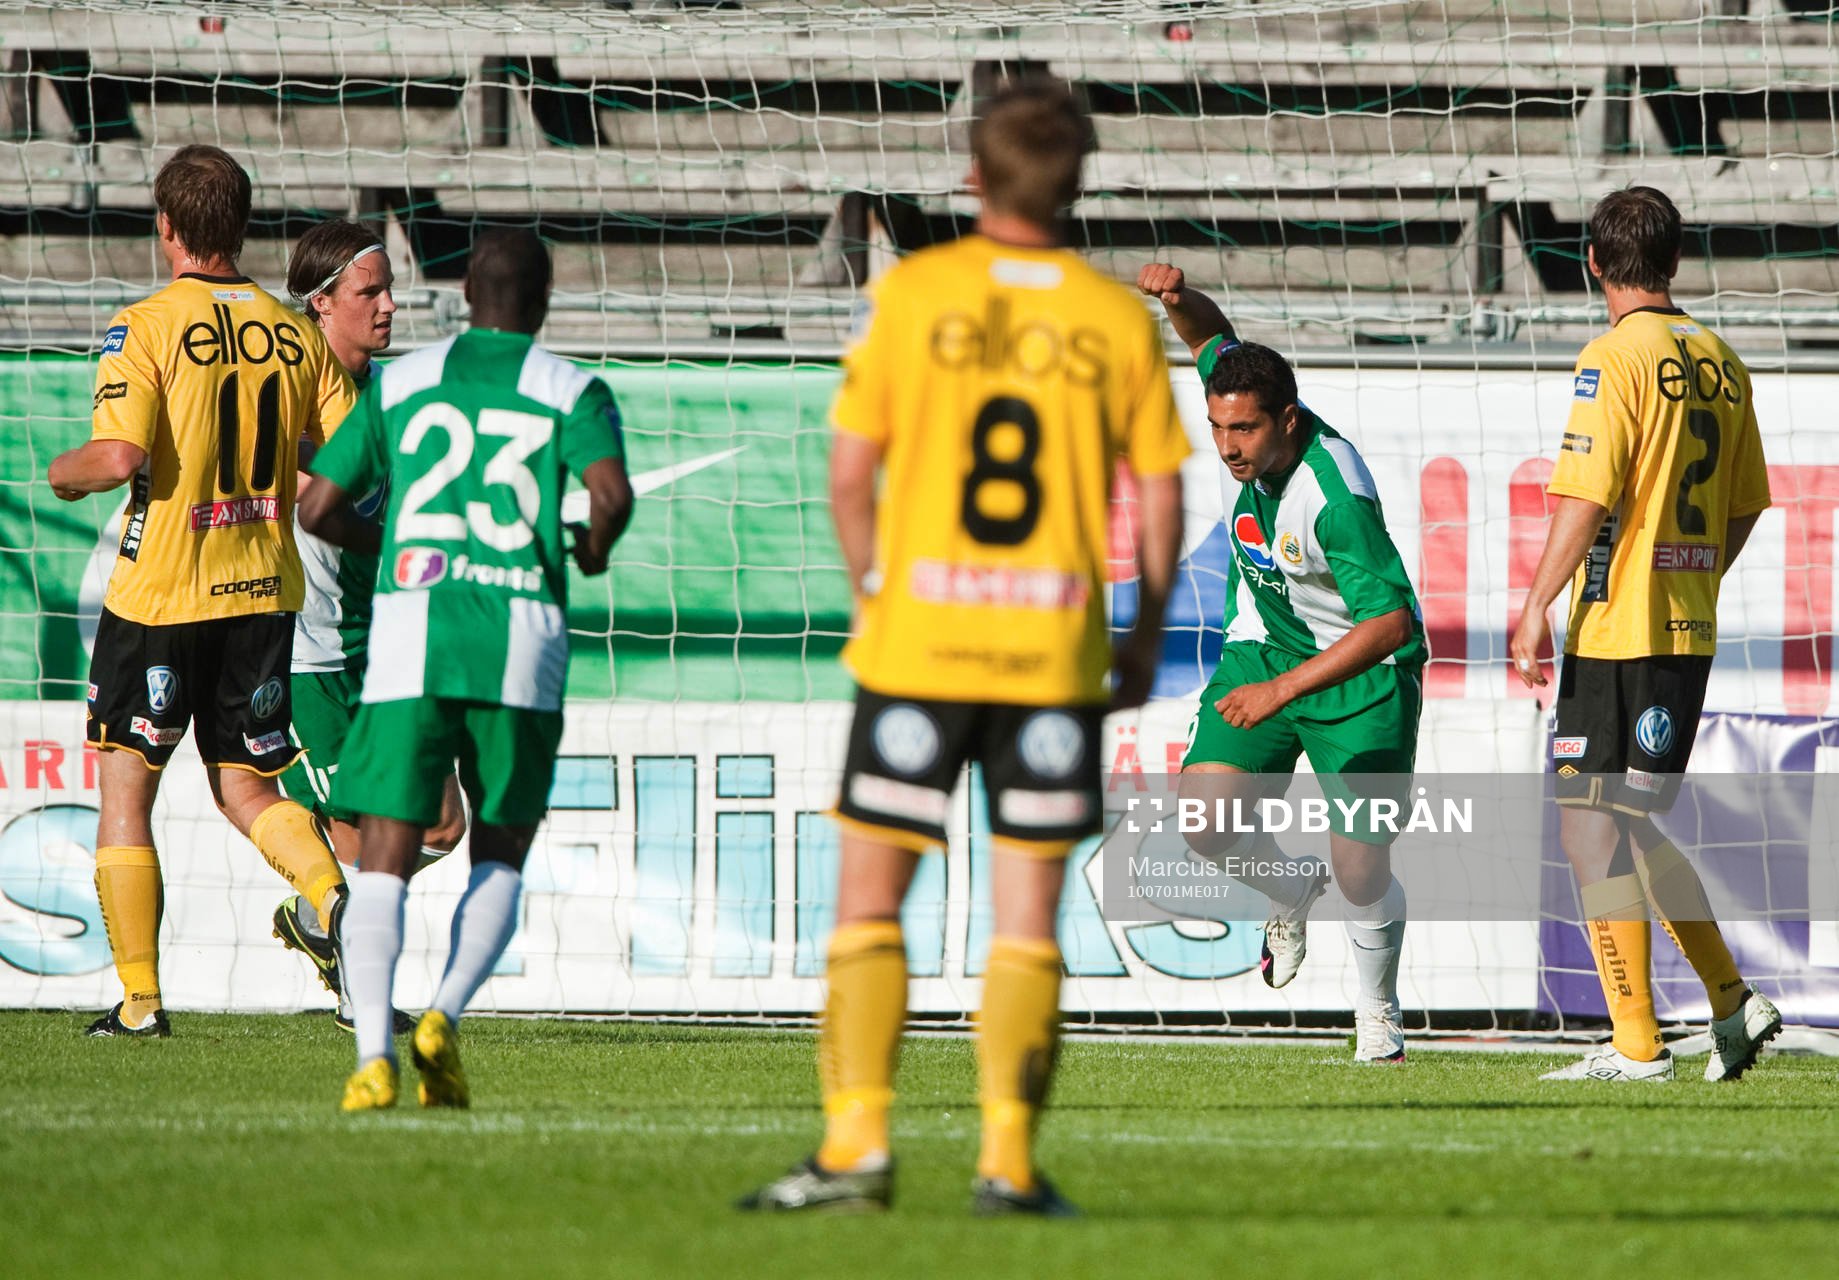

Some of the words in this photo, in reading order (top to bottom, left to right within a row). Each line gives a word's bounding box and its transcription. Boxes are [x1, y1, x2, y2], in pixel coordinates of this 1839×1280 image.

[184, 303, 303, 366] ellos
[1657, 338, 1741, 404] ellos
[218, 370, 281, 495] 11
[394, 402, 555, 552] 23
[961, 394, 1044, 547] 8
[1676, 409, 1721, 535] 2
[210, 576, 281, 596] COOPER
